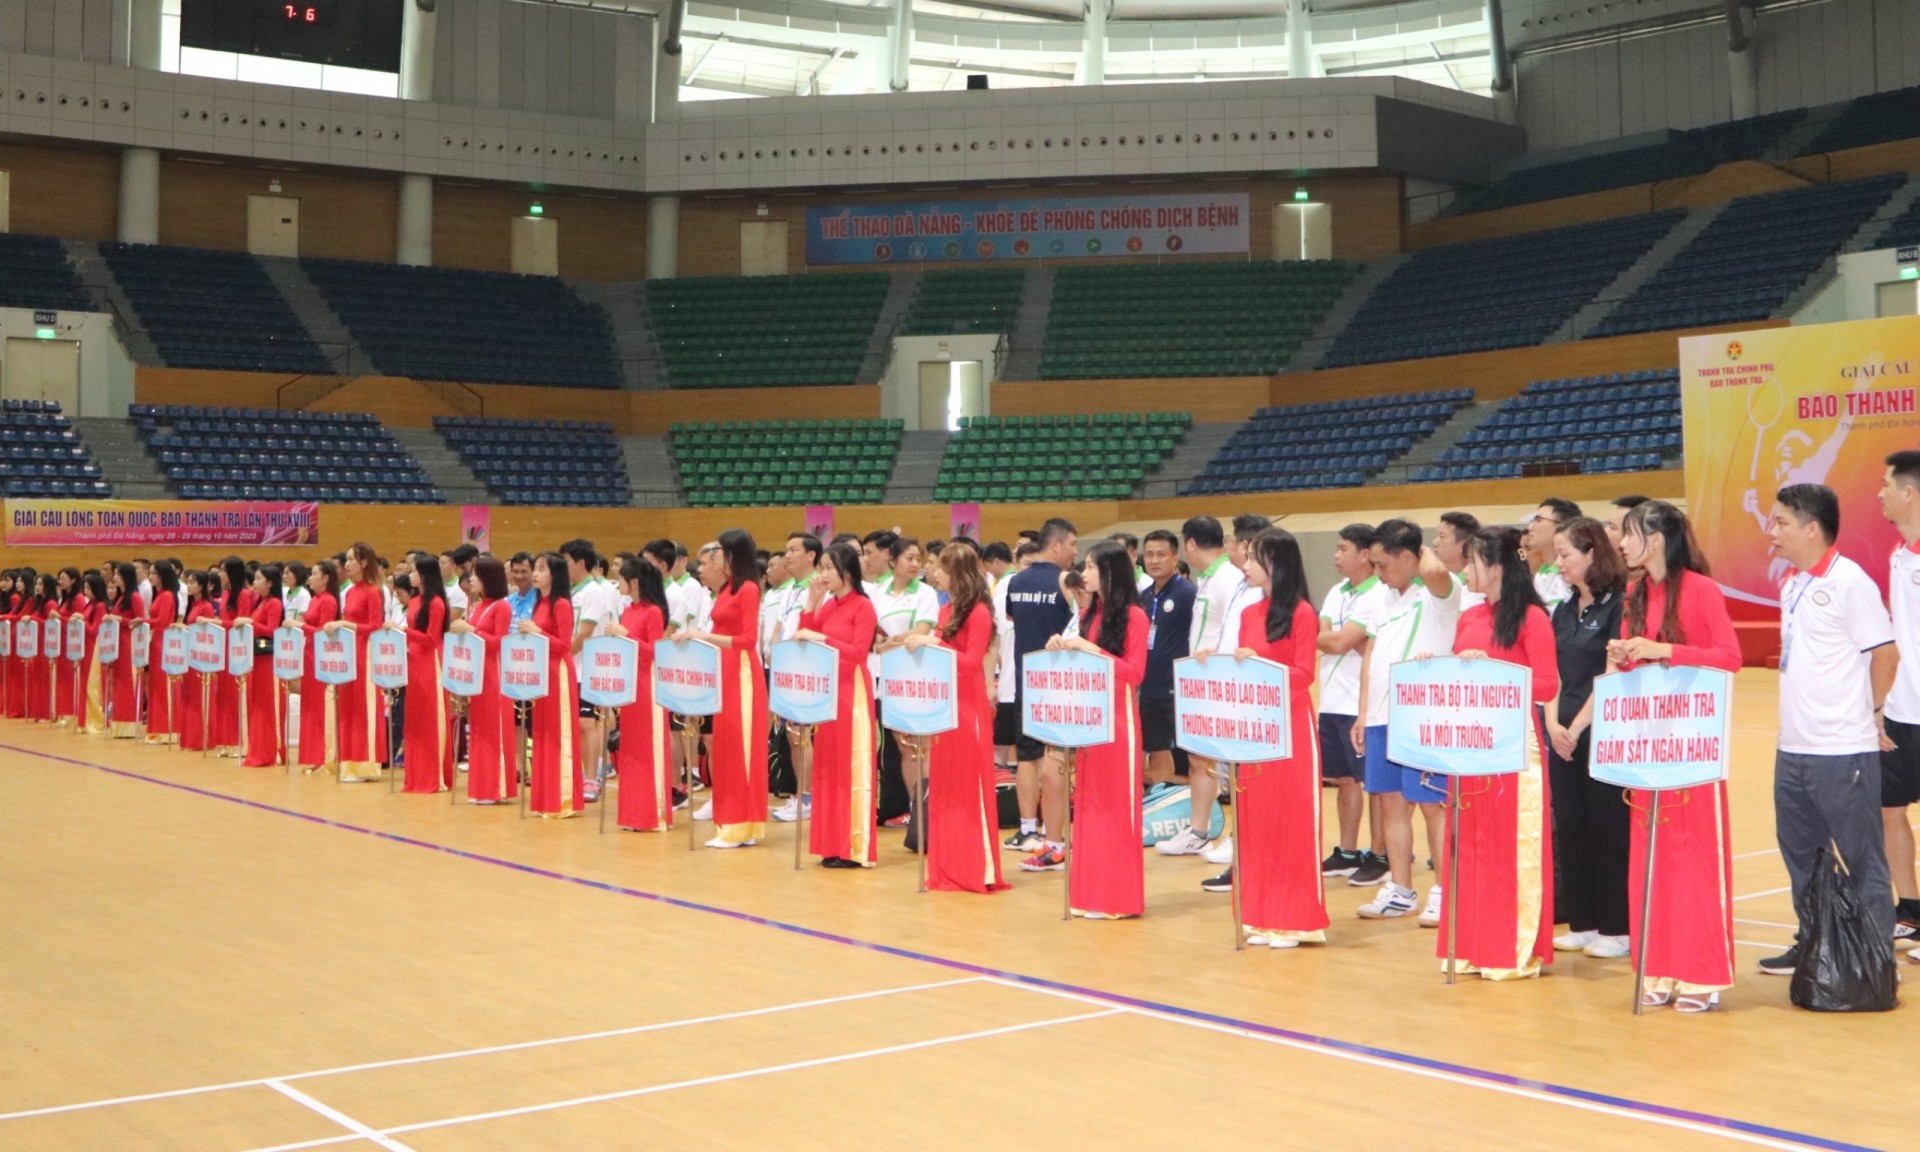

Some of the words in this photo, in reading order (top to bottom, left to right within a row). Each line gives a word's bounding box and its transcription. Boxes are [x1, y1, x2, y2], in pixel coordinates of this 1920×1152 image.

[305, 8, 315, 21] 6
[852, 214, 890, 238] THAO
[894, 210, 914, 236] ĐÀ
[919, 206, 961, 236] NẴNG
[1044, 205, 1096, 231] PHÒNG
[1101, 201, 1152, 230] CHỐNG
[1157, 207, 1193, 233] DỊCH
[1198, 202, 1240, 231] BỆNH
[1845, 388, 1915, 417] THANH
[185, 512, 218, 528] THANH
[222, 512, 241, 528] TRA
[595, 653, 610, 666] THANH
[611, 653, 621, 667] TRA
[657, 667, 674, 683] THANH
[675, 669, 686, 685] TRA
[686, 669, 703, 687] CHÍNH
[774, 672, 793, 688] THANH
[794, 673, 806, 691] TRA
[806, 673, 816, 696] BỘ
[817, 677, 823, 692] Y
[823, 673, 831, 694] TẾ
[884, 679, 904, 697] THANH
[905, 680, 917, 699] TRA
[917, 678, 927, 703] BỘ
[928, 679, 940, 704] NỘI
[940, 682, 949, 704] VỤ
[1026, 671, 1048, 690] THANH
[1049, 672, 1063, 691] TRA
[1063, 668, 1074, 695] BỘ
[1075, 668, 1091, 691] VĂN
[1179, 678, 1206, 700] THANH
[1208, 680, 1223, 702] TRA
[1225, 678, 1237, 708] BỘ
[1239, 683, 1254, 705] LAO
[1257, 681, 1281, 711] ĐỘNG
[1396, 684, 1426, 706] THANH
[1428, 684, 1446, 707] TRA
[1448, 680, 1461, 712] BỘ
[1464, 680, 1479, 708] TÀI
[1481, 680, 1521, 709] NGUYÊN
[1603, 696, 1618, 722] CƠ
[1621, 696, 1650, 723] QUAN
[1653, 694, 1690, 719] THANH
[1694, 692, 1716, 718] TRA
[1031, 697, 1044, 723] THỂ
[1044, 704, 1063, 724] THAO
[1063, 702, 1074, 724] VÀ
[1074, 706, 1085, 725] DU
[1086, 706, 1103, 730] LỊCH
[1182, 714, 1213, 737] THƯƠNG
[1216, 718, 1236, 740] BINH
[1238, 716, 1249, 742] VÀ
[1251, 718, 1264, 743] XÃ
[1265, 719, 1280, 749] HỘI
[1420, 719, 1432, 747] VÀ
[1434, 720, 1453, 748] MÔI
[1455, 720, 1494, 750] TRƯỜNG
[1596, 735, 1625, 764] GIÁM
[1628, 734, 1649, 764] SÁT
[1651, 733, 1684, 763] NGÂN
[1687, 731, 1720, 762] HÀNG
